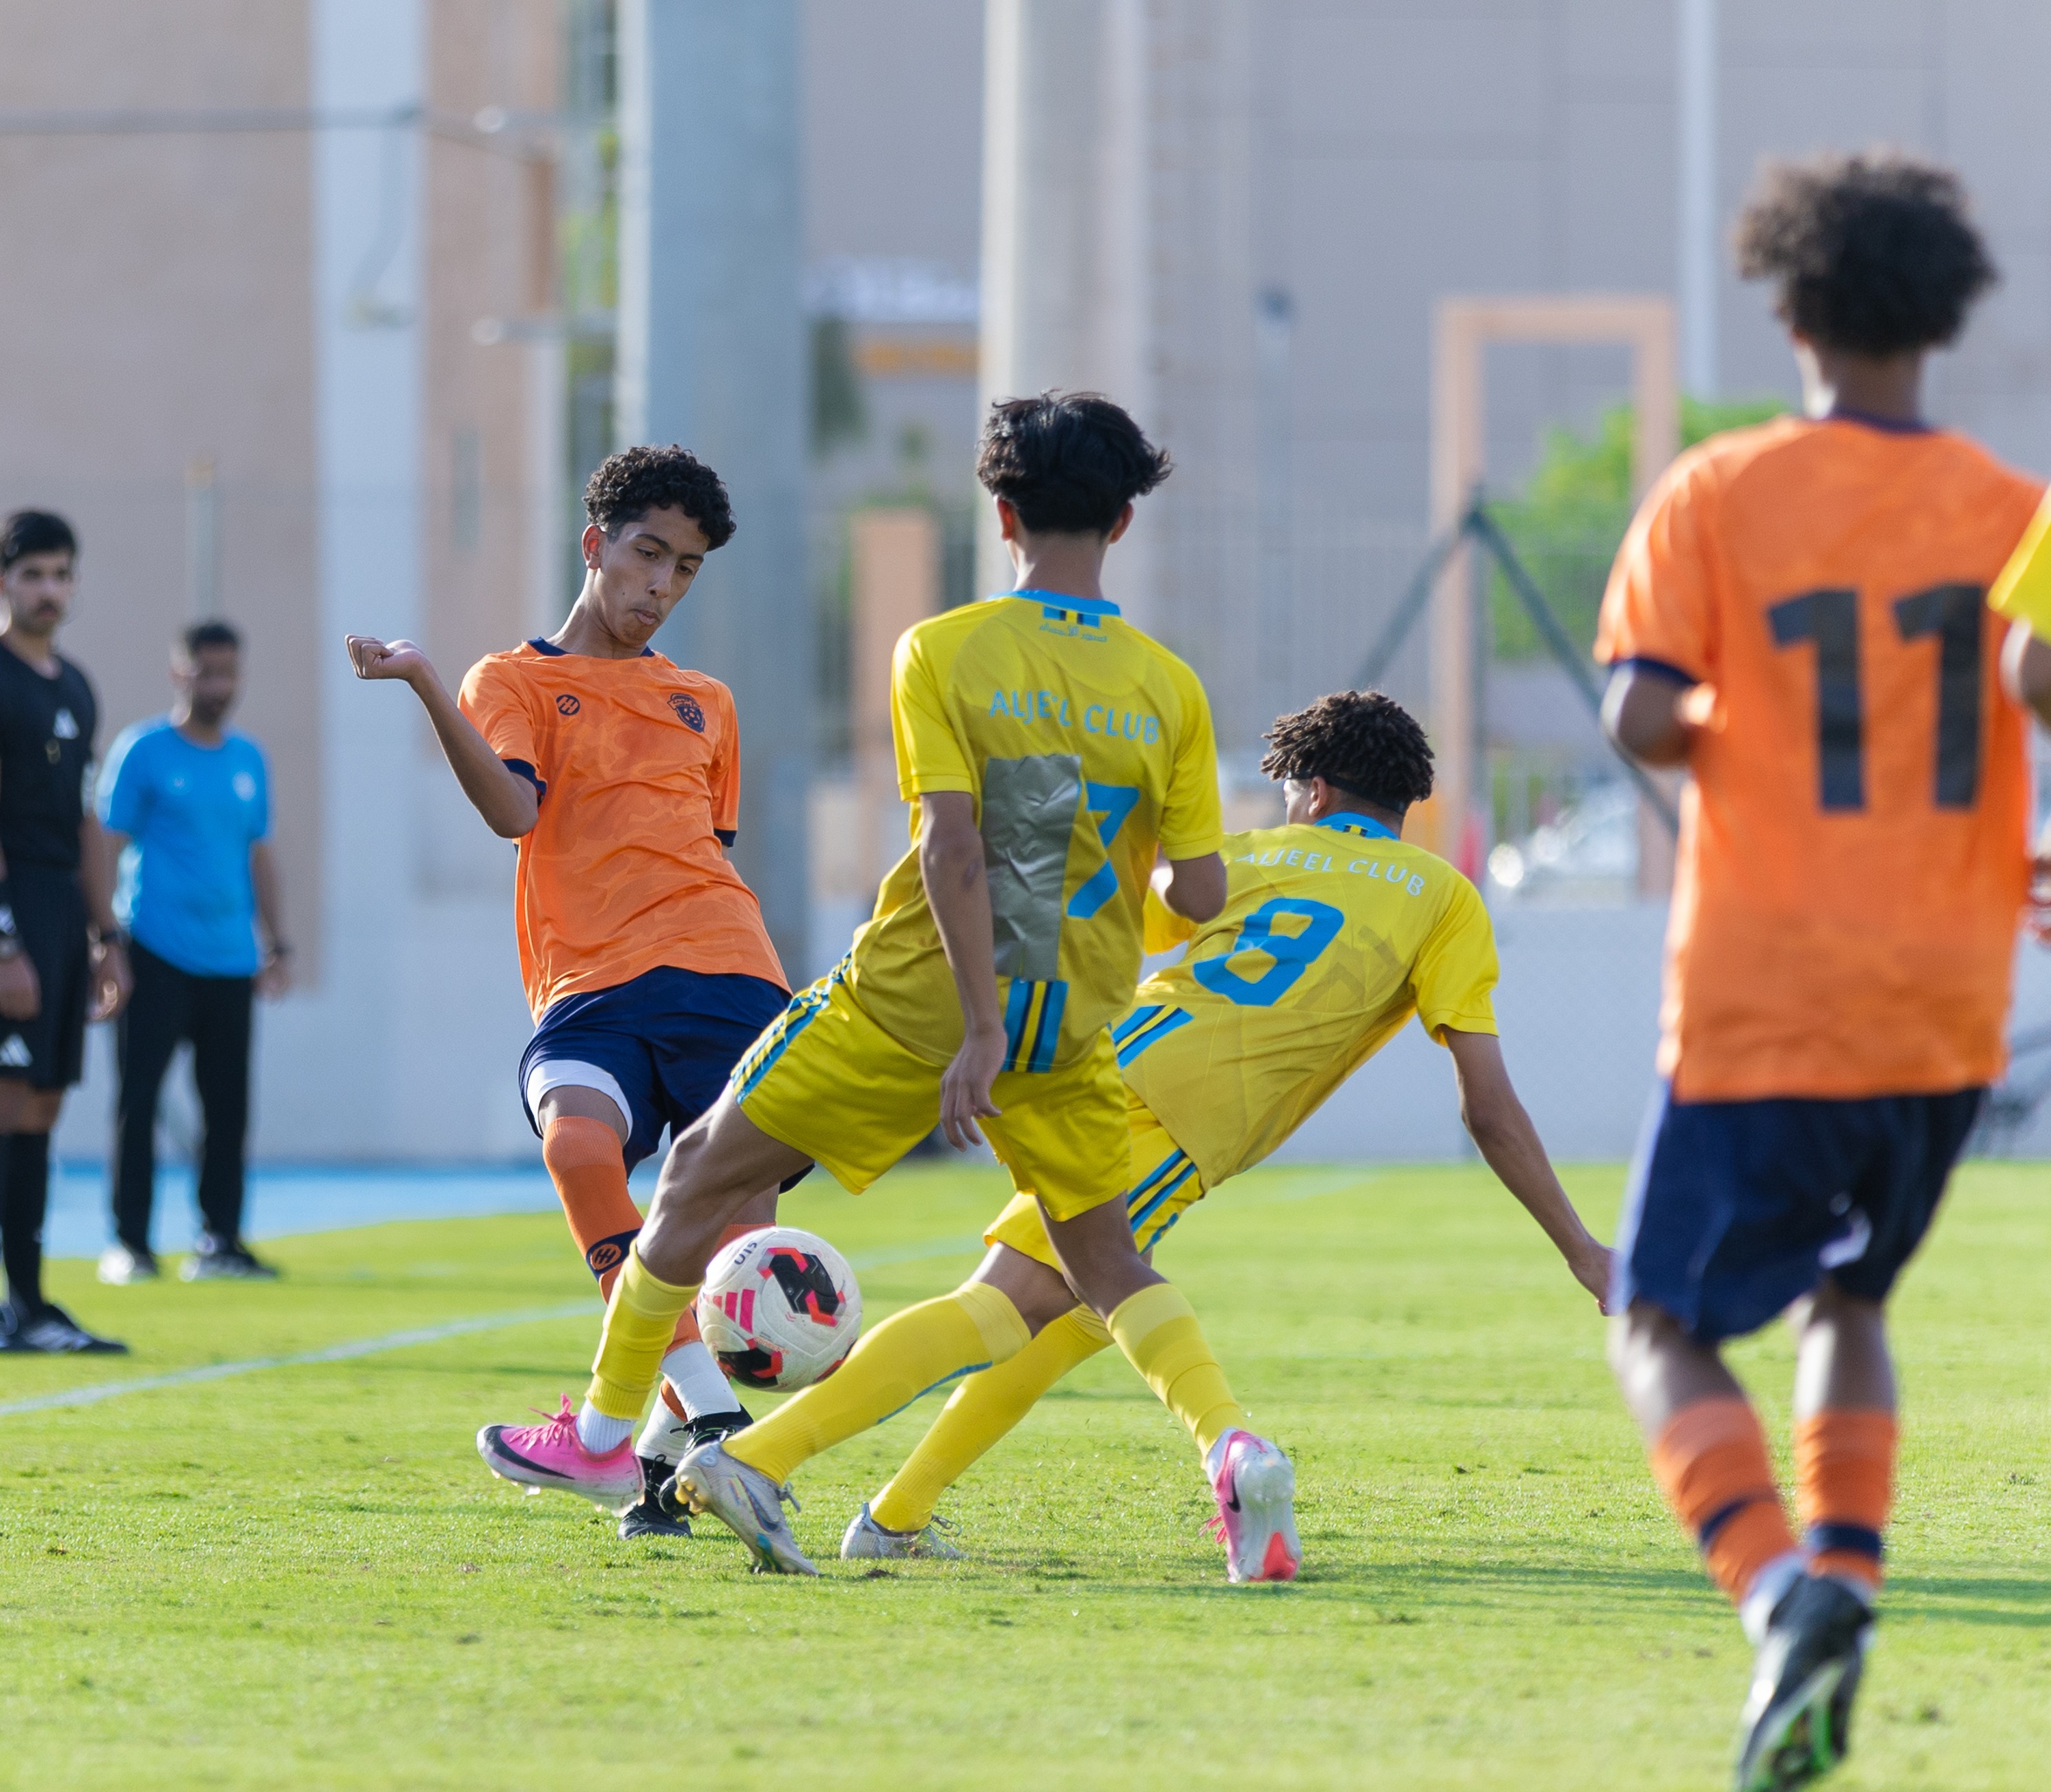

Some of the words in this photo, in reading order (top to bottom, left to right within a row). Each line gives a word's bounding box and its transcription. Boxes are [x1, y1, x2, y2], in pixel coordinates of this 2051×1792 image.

[1084, 704, 1159, 745] CLUB
[1768, 583, 1983, 810] 11
[1235, 848, 1334, 872] ALJEEL
[1348, 859, 1425, 896] CLUB
[1193, 897, 1345, 1006] 8
